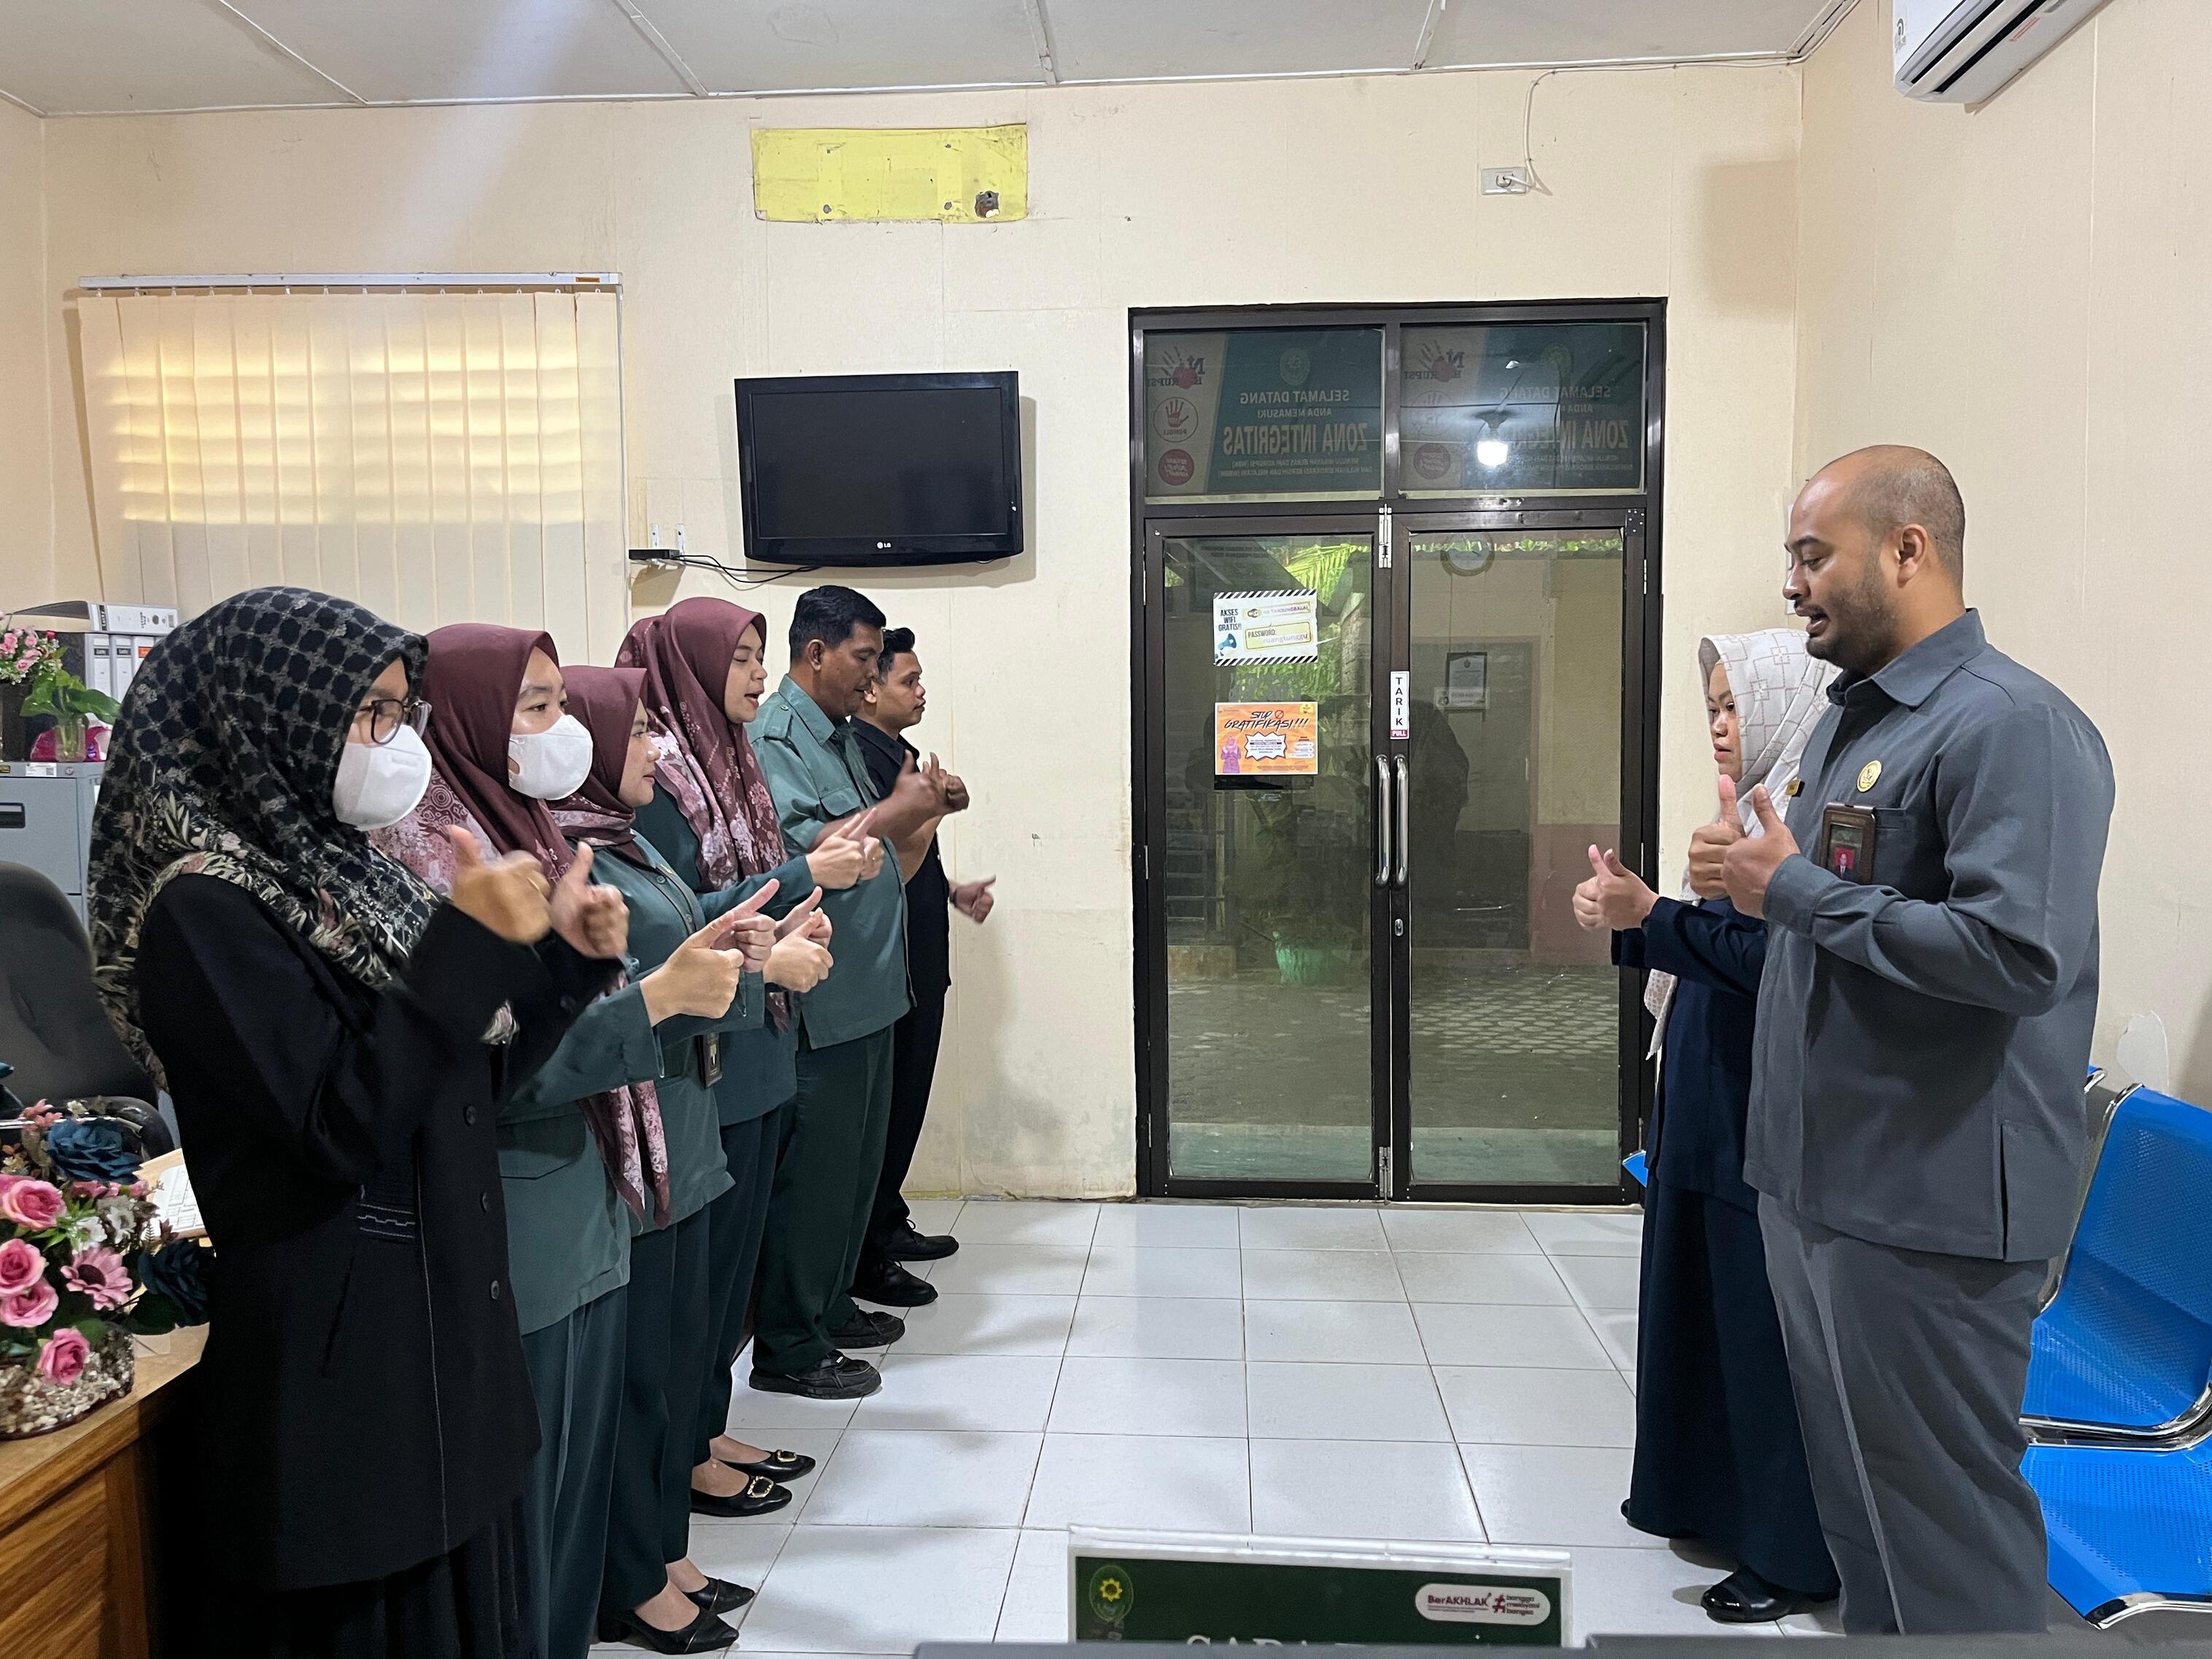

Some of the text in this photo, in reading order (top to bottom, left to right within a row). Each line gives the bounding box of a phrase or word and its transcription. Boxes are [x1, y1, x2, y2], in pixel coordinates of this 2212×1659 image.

[1220, 608, 1238, 616] AKSES
[1223, 616, 1236, 624] WIFI
[1248, 629, 1277, 638] PASSWORD:
[1395, 677, 1403, 726] TARIK
[1427, 1593, 1490, 1606] BerAKHLAK
